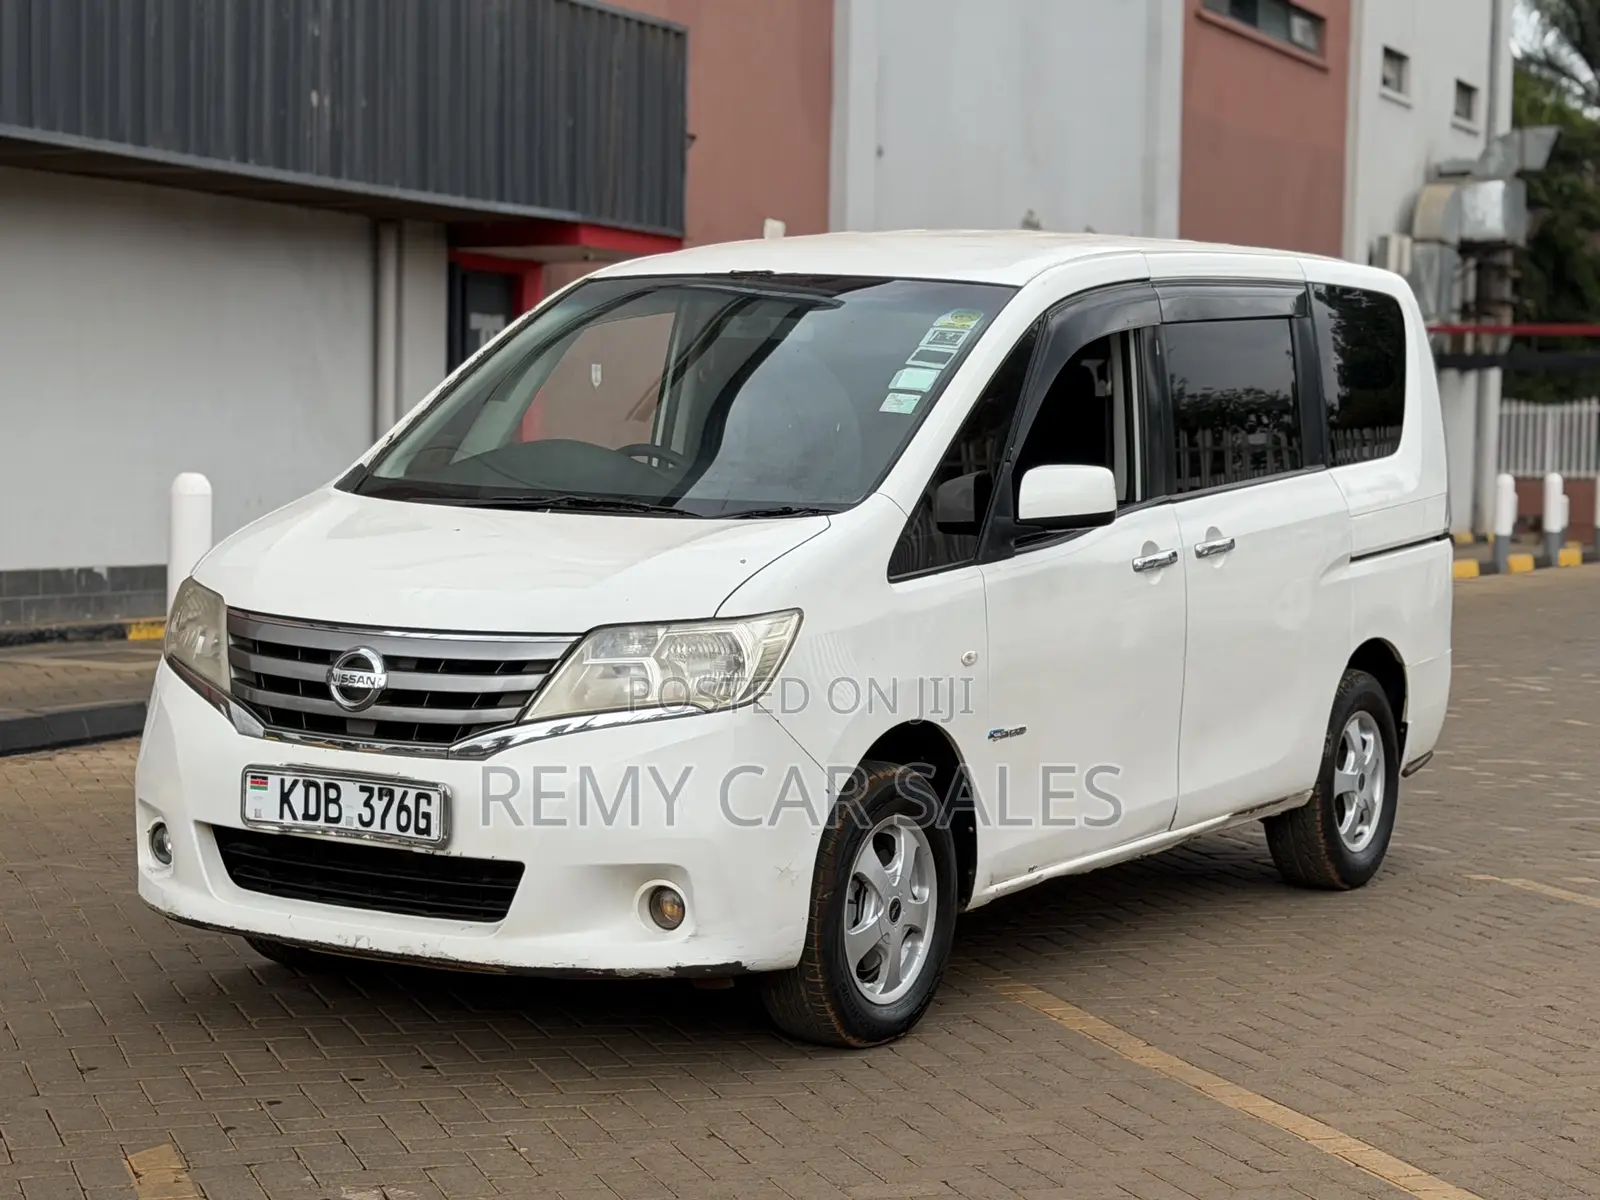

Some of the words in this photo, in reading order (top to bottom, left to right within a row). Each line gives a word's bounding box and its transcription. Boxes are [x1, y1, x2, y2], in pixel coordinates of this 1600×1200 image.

[331, 672, 376, 685] NISSAN
[279, 777, 343, 825] KDB
[358, 785, 432, 837] 376G
